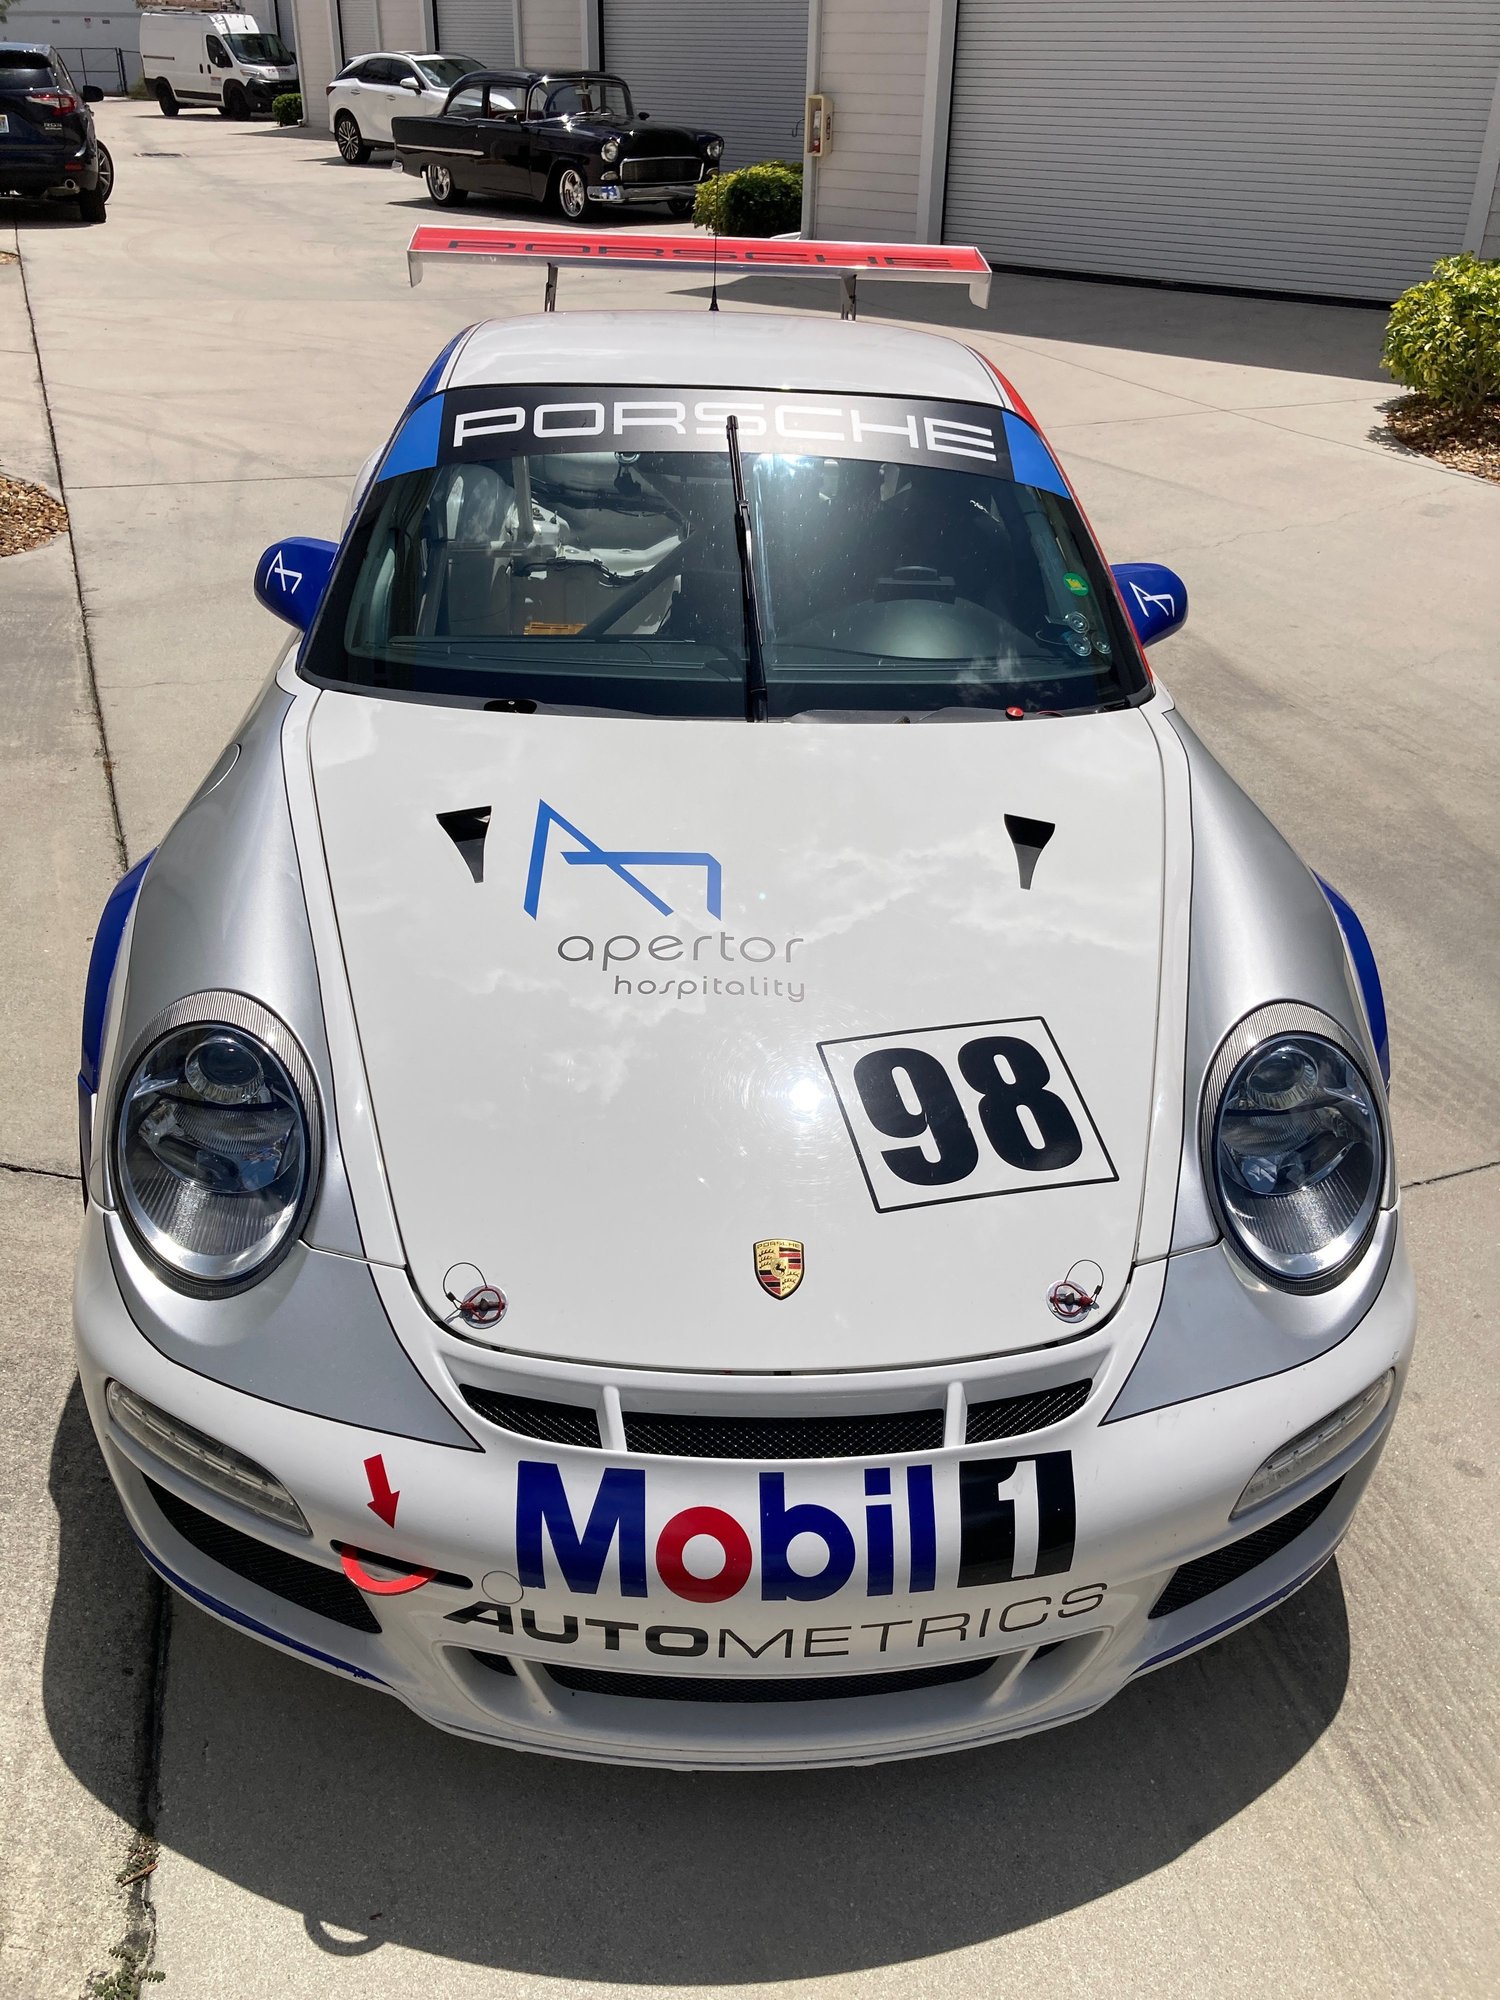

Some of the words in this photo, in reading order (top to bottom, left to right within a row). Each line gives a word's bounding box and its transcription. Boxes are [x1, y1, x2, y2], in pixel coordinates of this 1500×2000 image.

[448, 240, 953, 268] PORSCHE
[453, 402, 997, 462] PORSCHE
[557, 931, 804, 971] apertor
[614, 975, 805, 1003] hospitality
[853, 1036, 1083, 1186] 98
[516, 1460, 936, 1603] Mobil
[443, 1582, 1108, 1659] AUTOMETRICS
